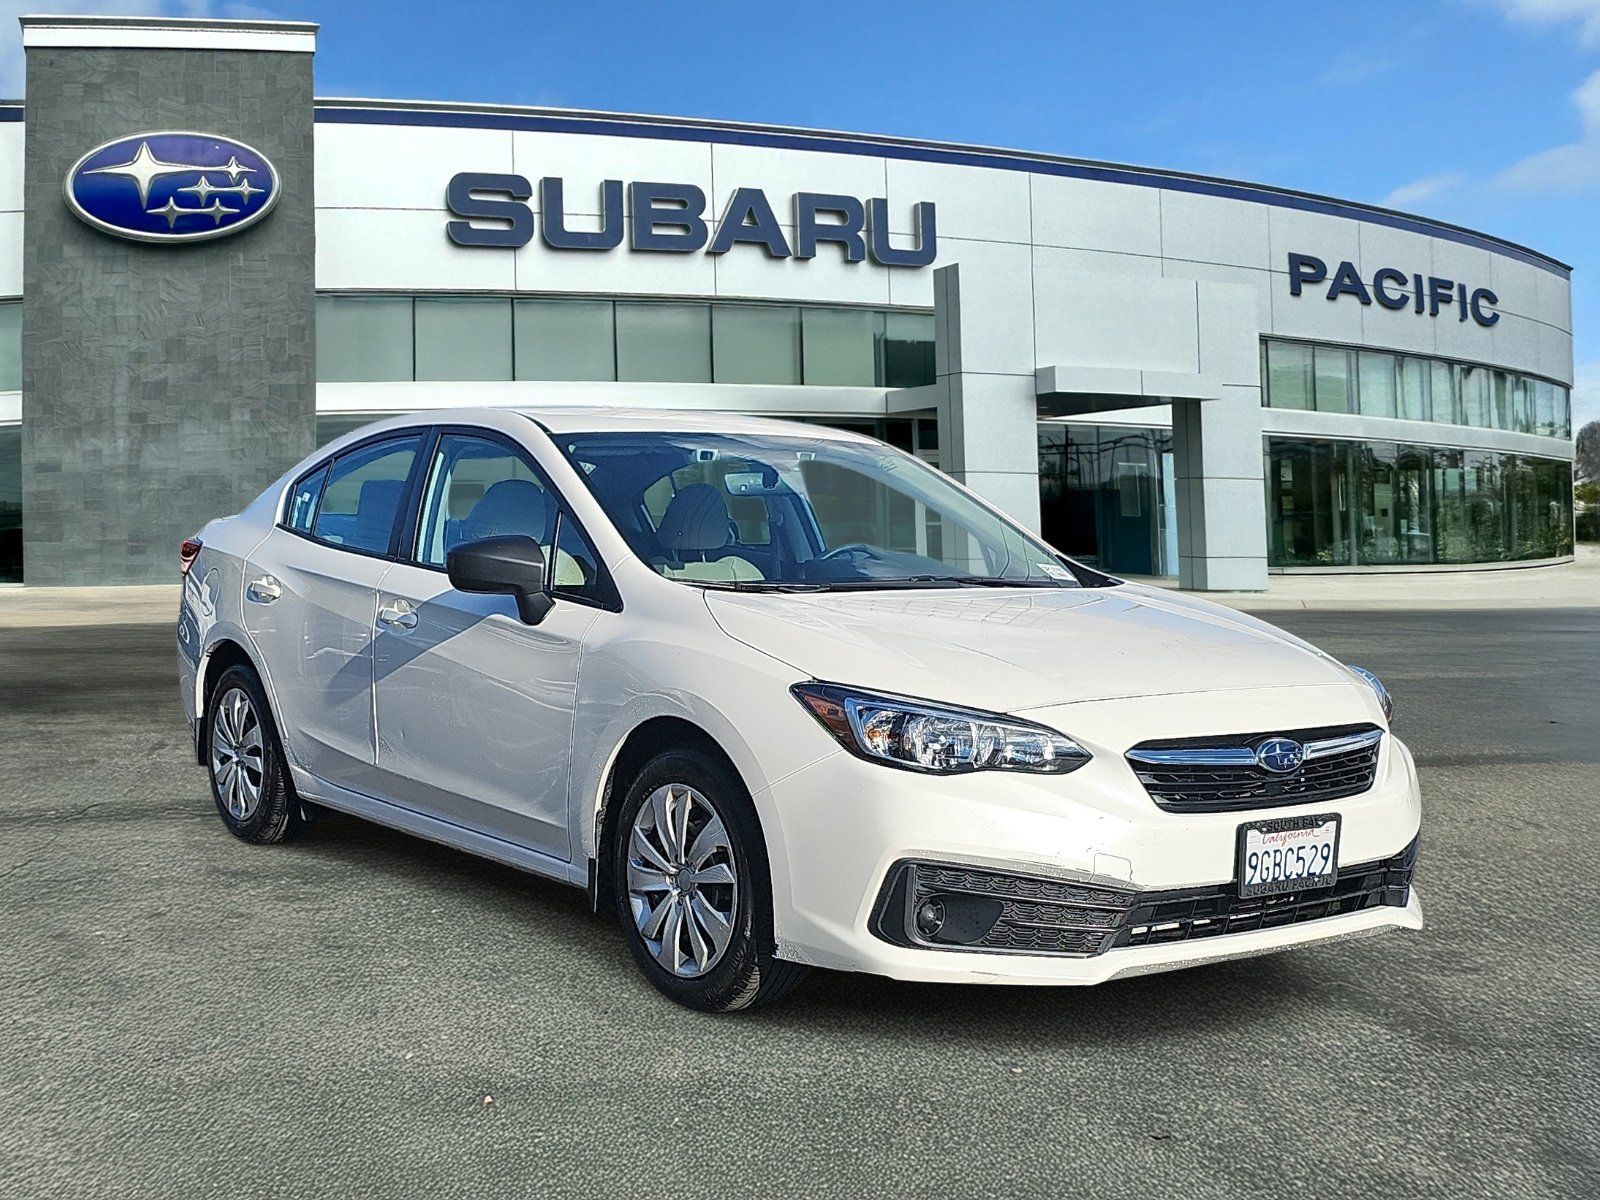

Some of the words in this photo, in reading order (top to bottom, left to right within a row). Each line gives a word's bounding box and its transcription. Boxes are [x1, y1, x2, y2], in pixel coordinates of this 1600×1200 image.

[446, 172, 937, 267] SUBARU
[1288, 252, 1500, 327] PACIFIC
[1262, 828, 1321, 847] California
[1267, 818, 1299, 831] SOUTH
[1248, 843, 1331, 886] 9GBC529
